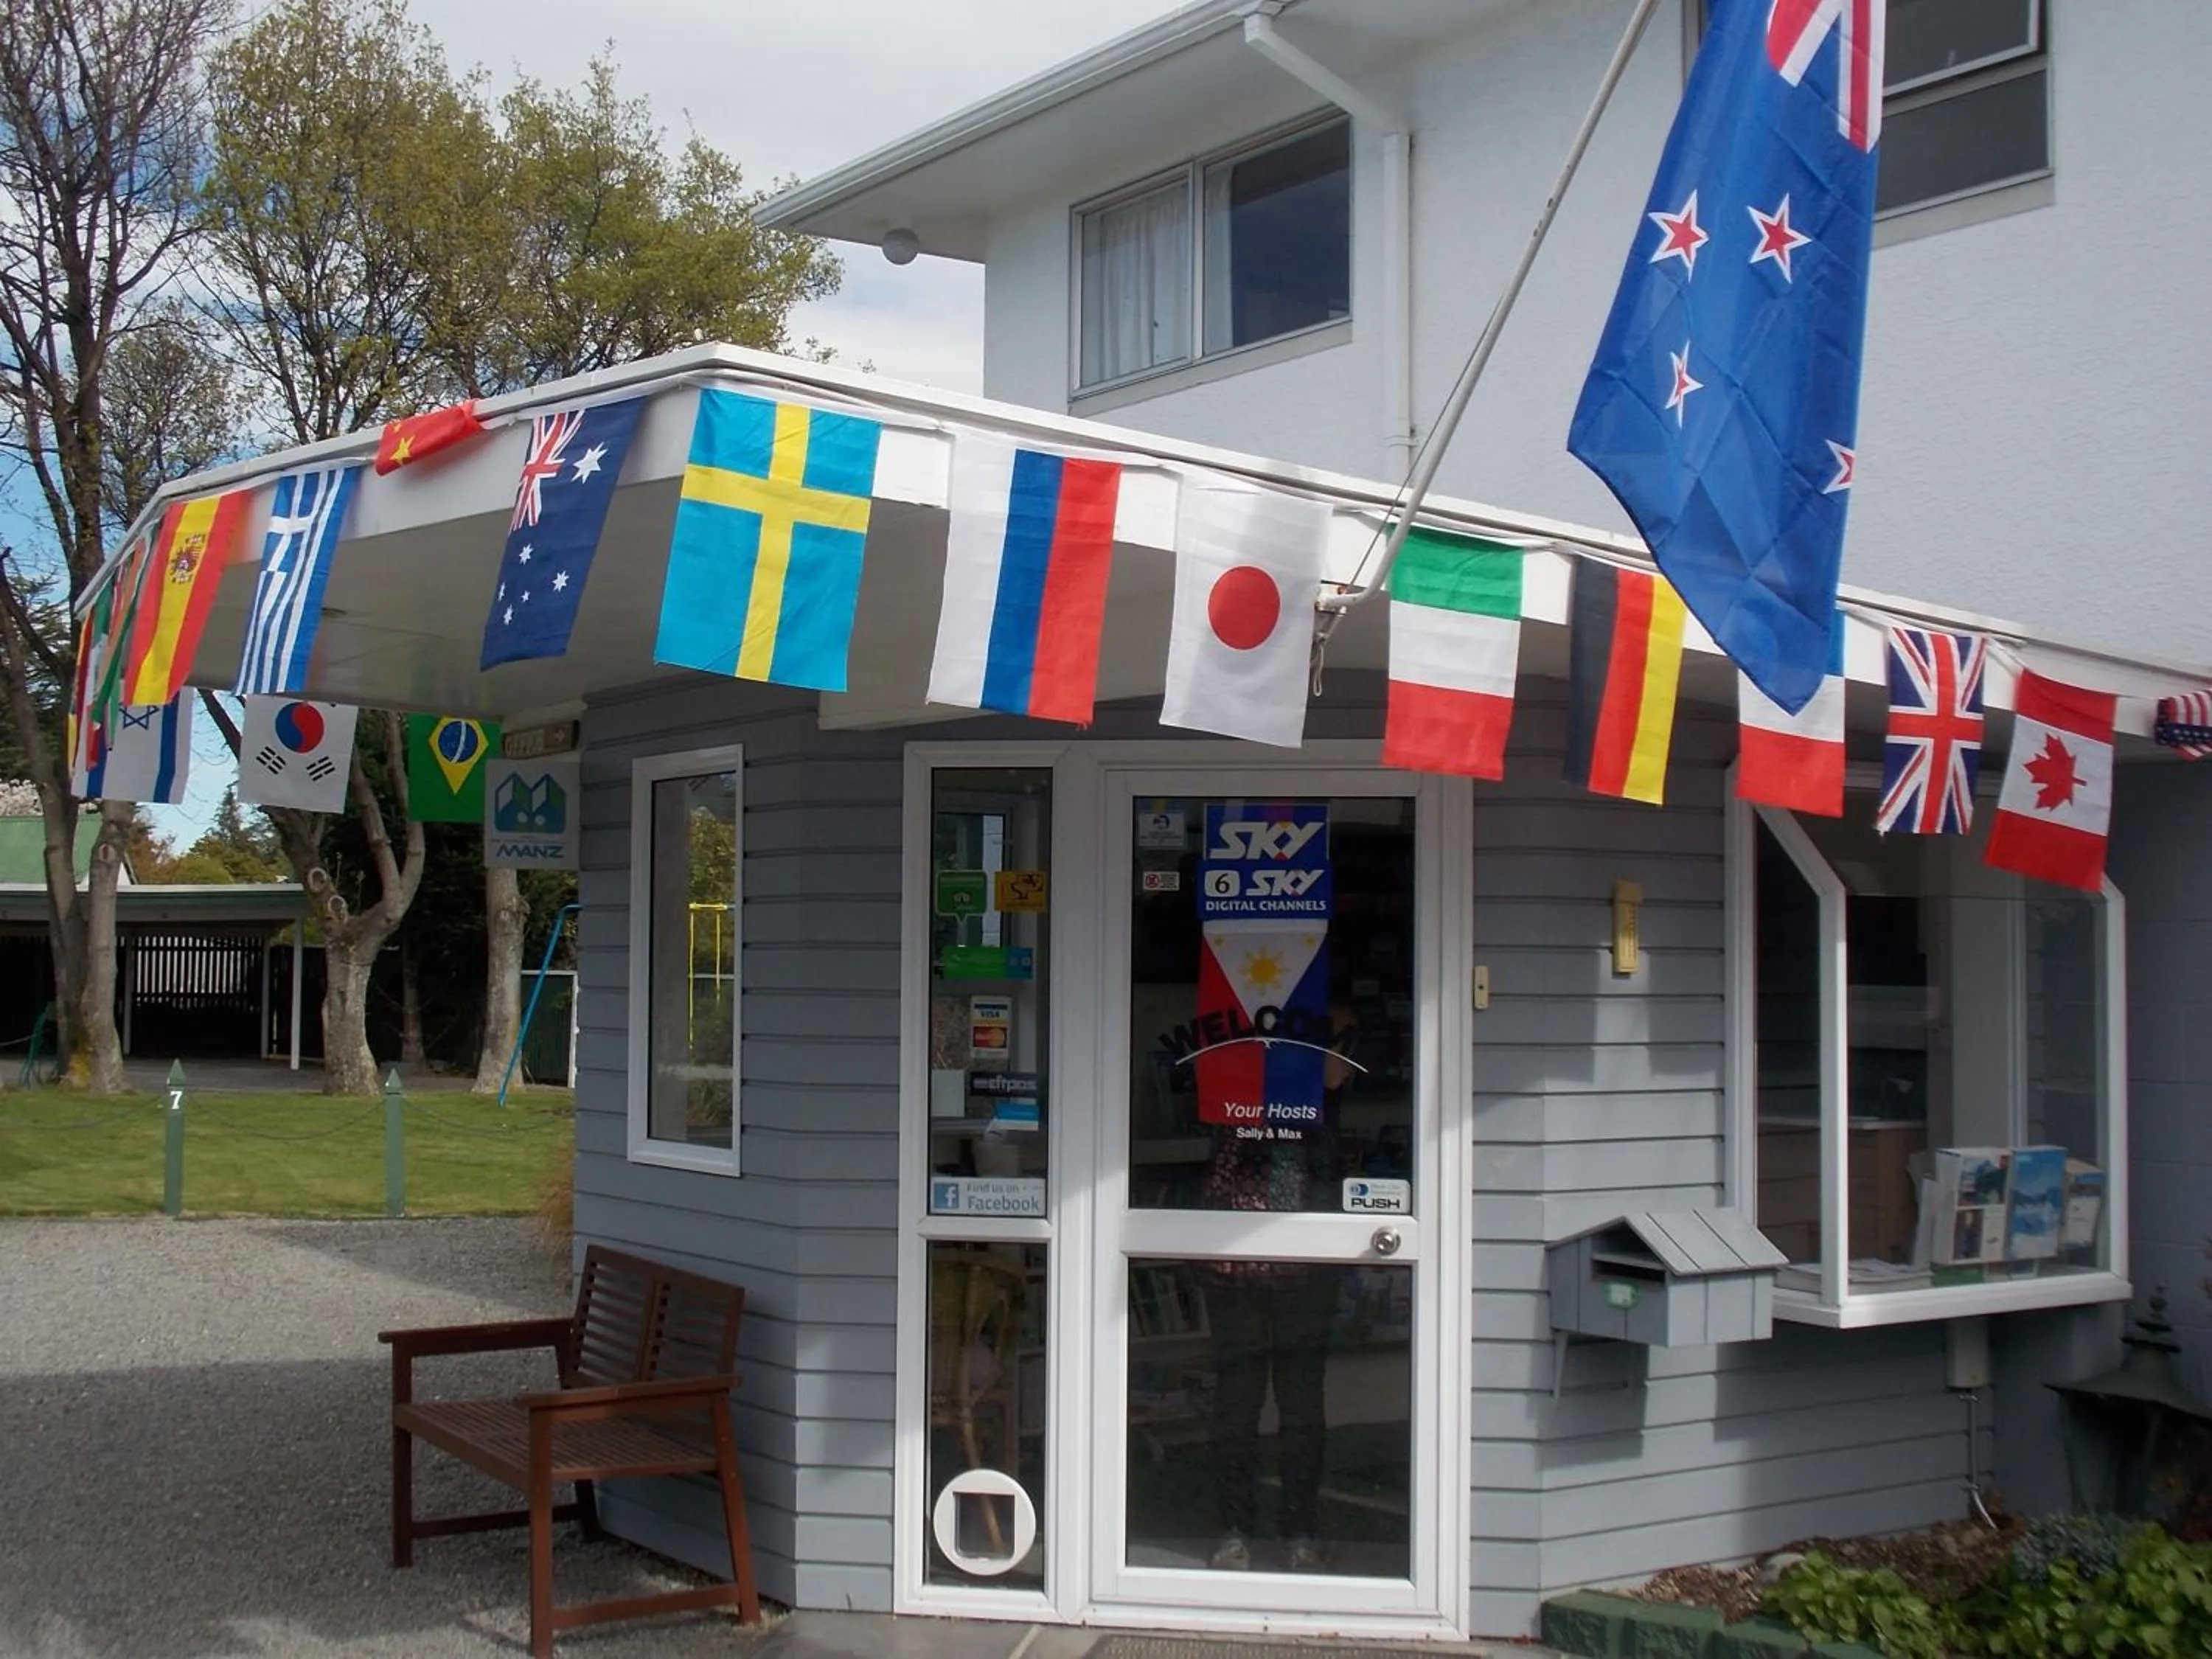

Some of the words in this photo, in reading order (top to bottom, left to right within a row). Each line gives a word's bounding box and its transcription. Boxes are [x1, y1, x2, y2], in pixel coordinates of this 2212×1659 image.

[1209, 821, 1324, 860] SKY
[497, 844, 564, 859] MANZ
[1214, 872, 1230, 893] 6
[1245, 869, 1325, 896] SKY
[1206, 900, 1256, 911] DIGITAL
[1259, 900, 1326, 911] CHANNELS
[170, 1091, 183, 1110] 7
[1224, 1102, 1264, 1118] Your
[1268, 1102, 1317, 1119] Hosts
[1236, 1127, 1264, 1140] Sally
[1266, 1127, 1275, 1139] &
[1278, 1127, 1302, 1139] Max
[967, 1182, 990, 1192] Find
[967, 1195, 1040, 1211] Facebook
[1351, 1197, 1400, 1209] PUSH
